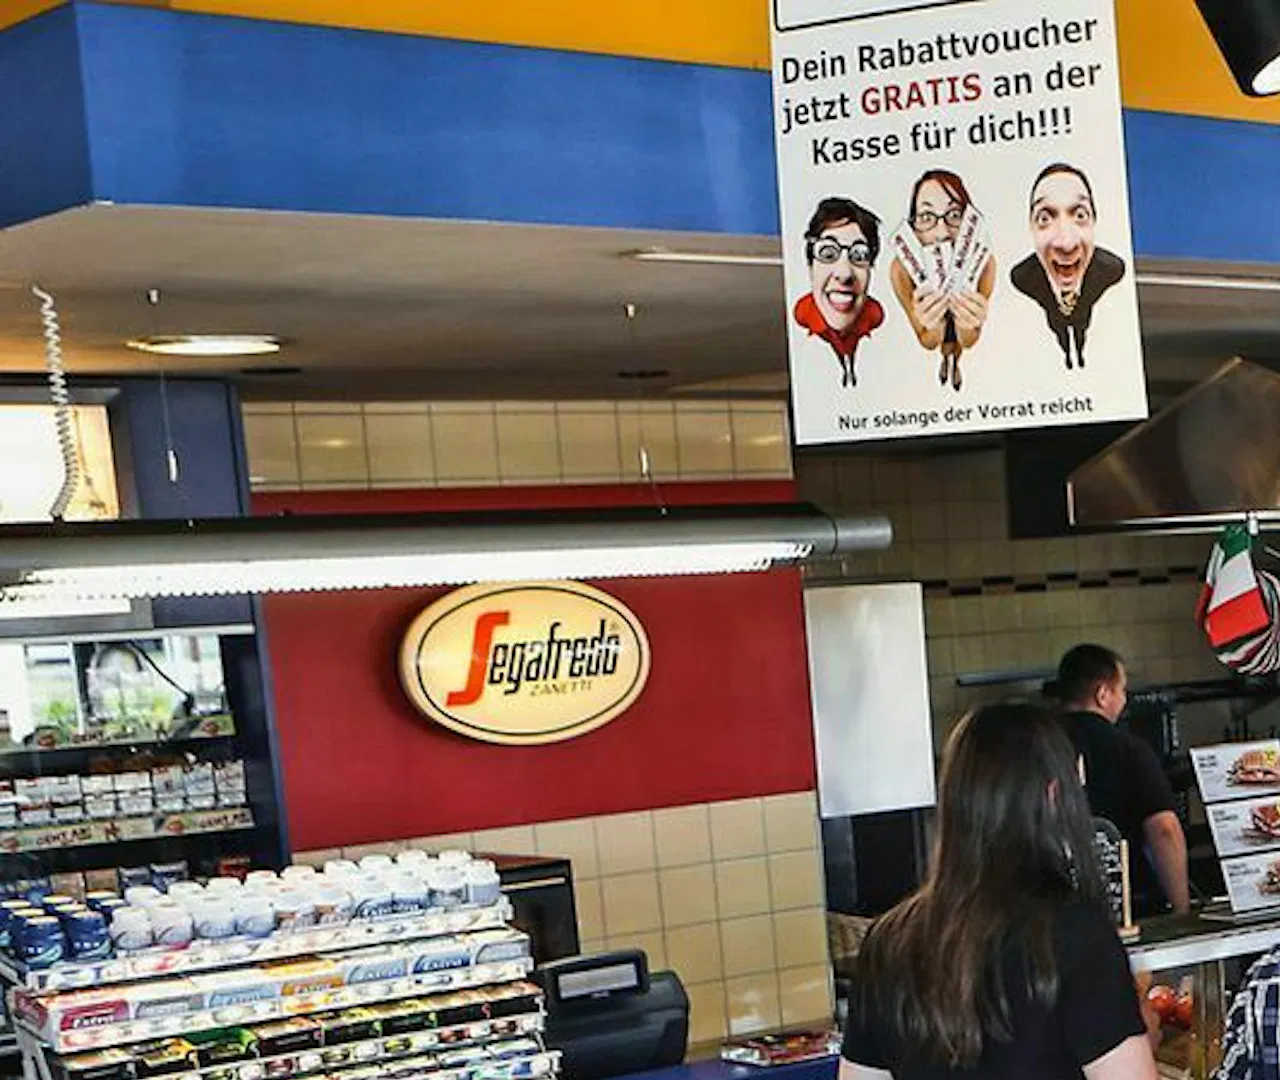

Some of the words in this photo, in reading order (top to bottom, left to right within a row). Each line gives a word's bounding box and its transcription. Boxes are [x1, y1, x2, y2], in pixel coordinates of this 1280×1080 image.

[782, 49, 847, 84] Dein
[858, 16, 1098, 73] Rabattvoucher
[782, 92, 850, 134] jetzt
[861, 73, 982, 116] GRATIS
[994, 74, 1032, 98] an
[1045, 60, 1102, 91] der
[812, 132, 900, 165] Kasse
[910, 122, 956, 153] für
[967, 106, 1073, 145] dich!!!
[839, 412, 867, 430] Nur
[873, 407, 940, 428] solange
[944, 405, 972, 423] der
[978, 401, 1034, 419] Vorrat
[1040, 396, 1094, 415] reicht
[447, 610, 620, 707] Segafredo
[530, 680, 592, 696] ZANETTI
